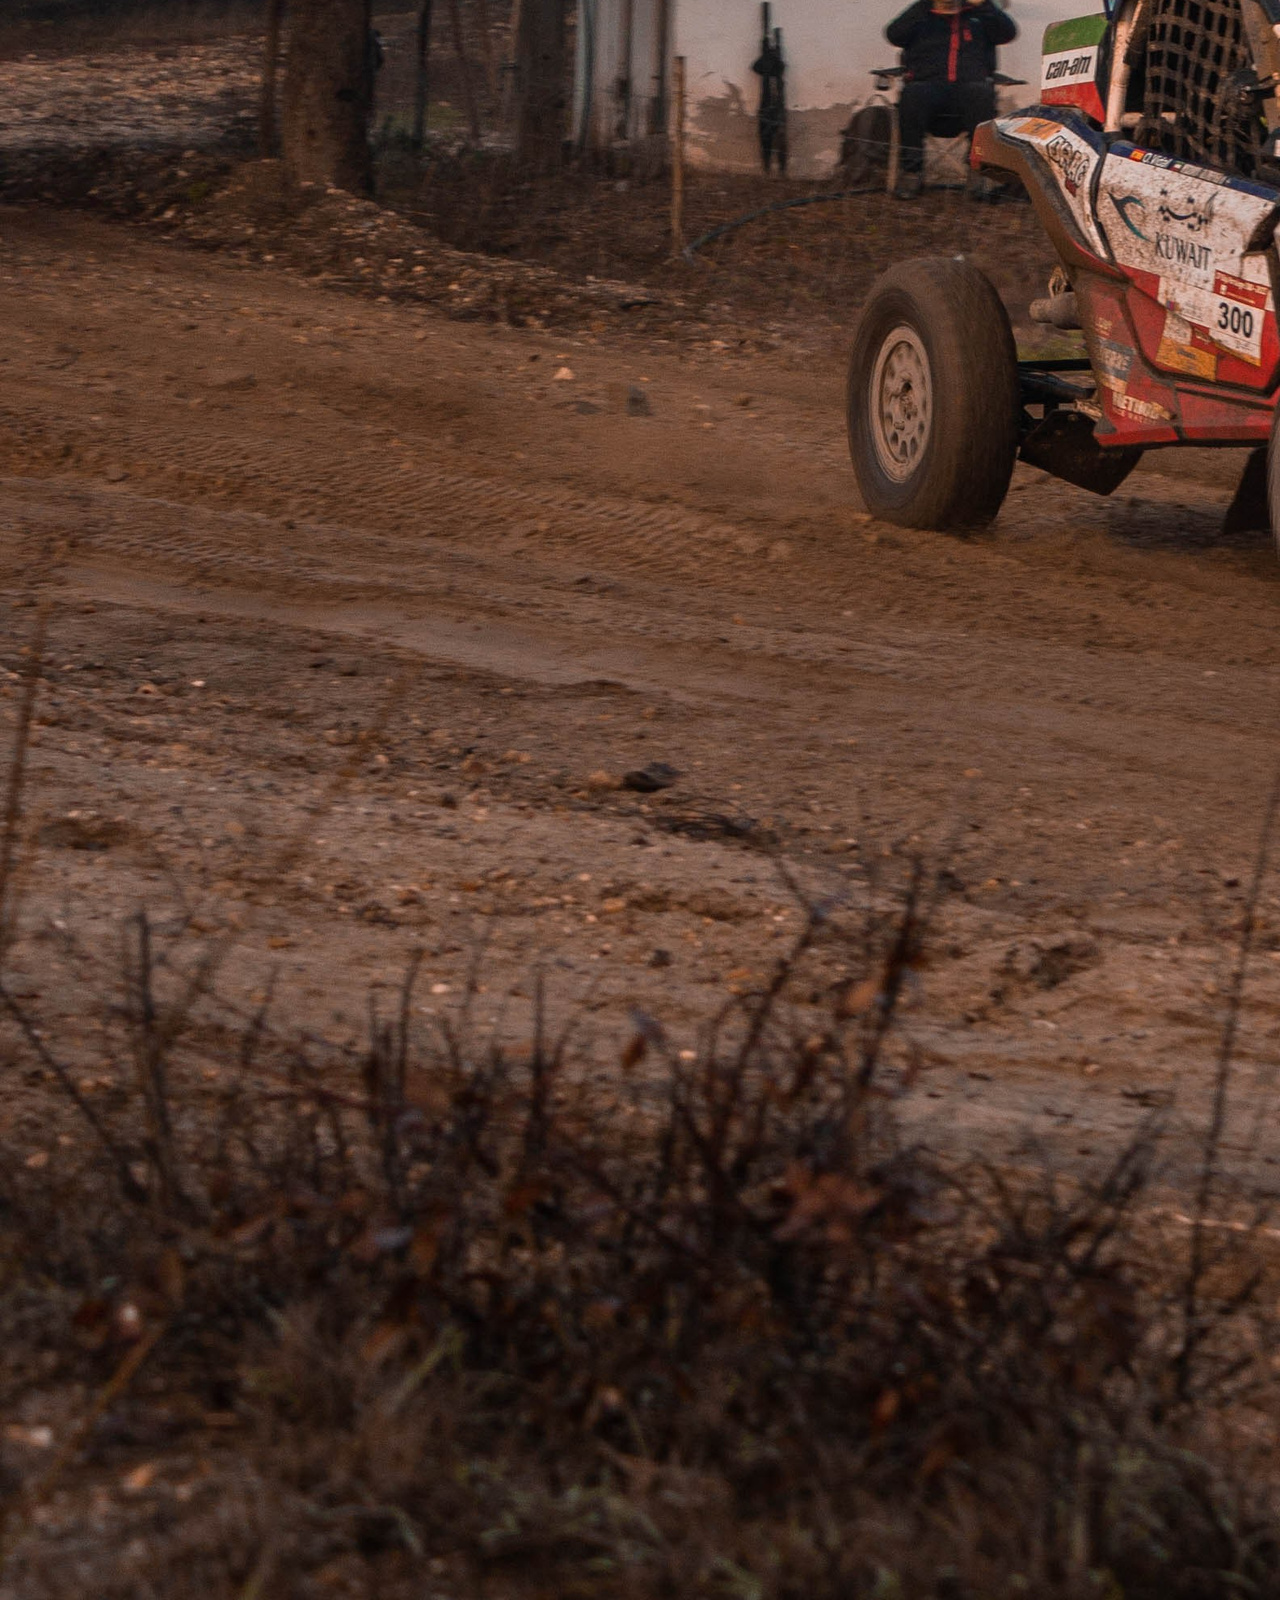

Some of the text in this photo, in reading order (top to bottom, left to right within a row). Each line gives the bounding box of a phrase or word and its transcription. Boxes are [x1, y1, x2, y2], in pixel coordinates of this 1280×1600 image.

[1046, 56, 1092, 80] can-am
[1155, 231, 1212, 271] KUWAIT
[1218, 302, 1254, 338] 300
